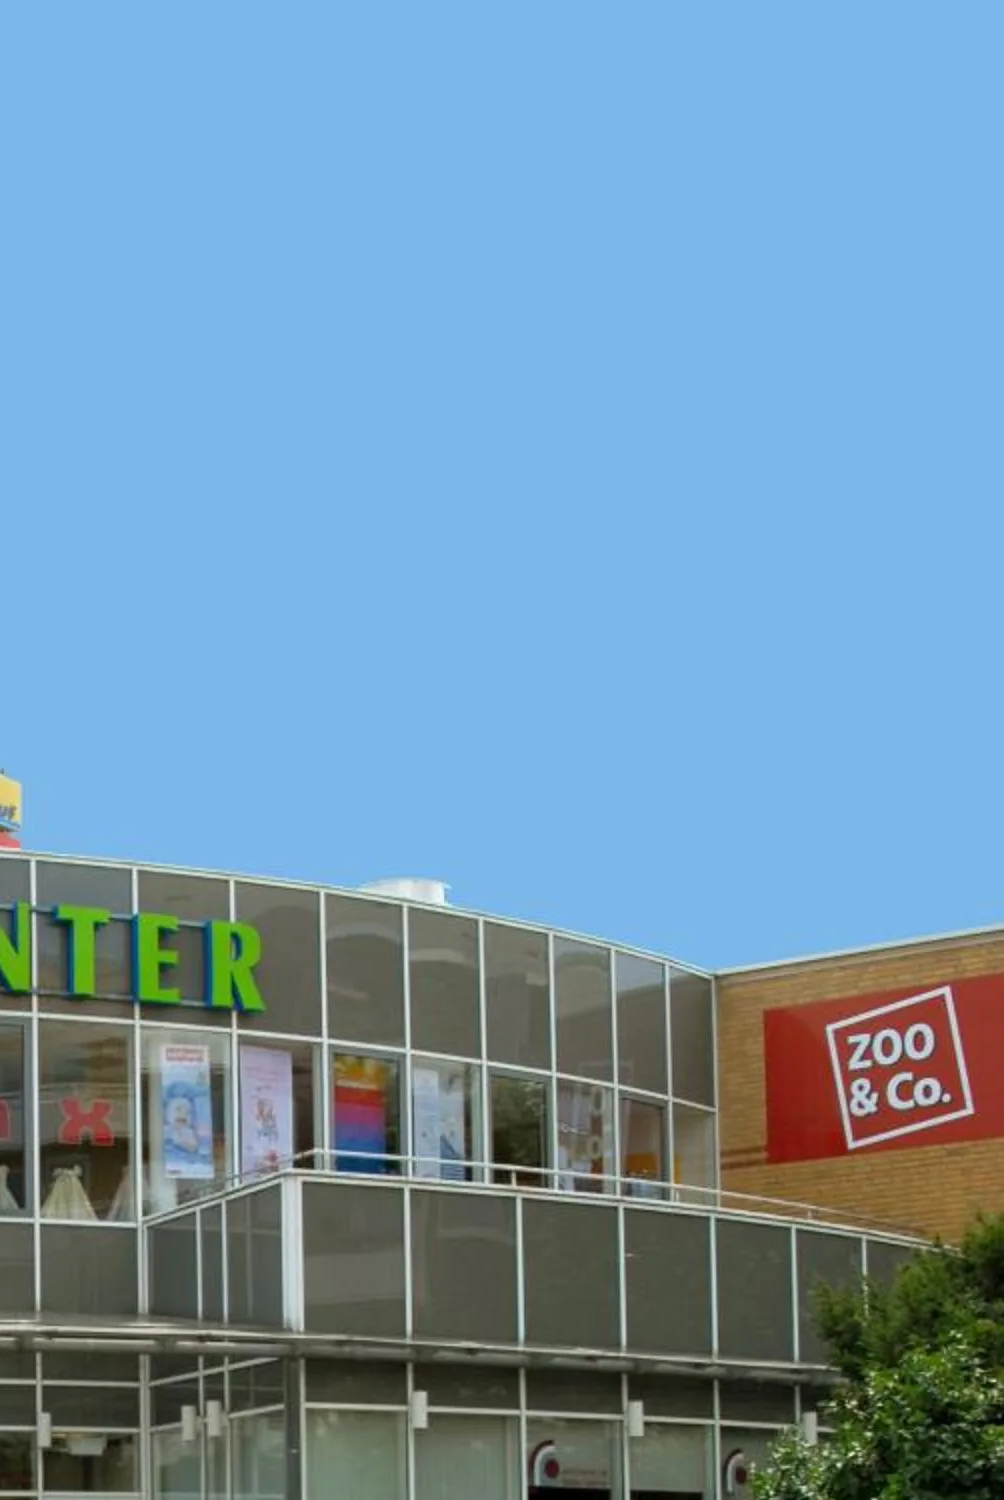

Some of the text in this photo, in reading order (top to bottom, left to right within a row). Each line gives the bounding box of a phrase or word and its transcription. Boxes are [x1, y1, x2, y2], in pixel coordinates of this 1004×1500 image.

[847, 1023, 935, 1071] ZOO
[849, 1071, 952, 1117] & Co.
